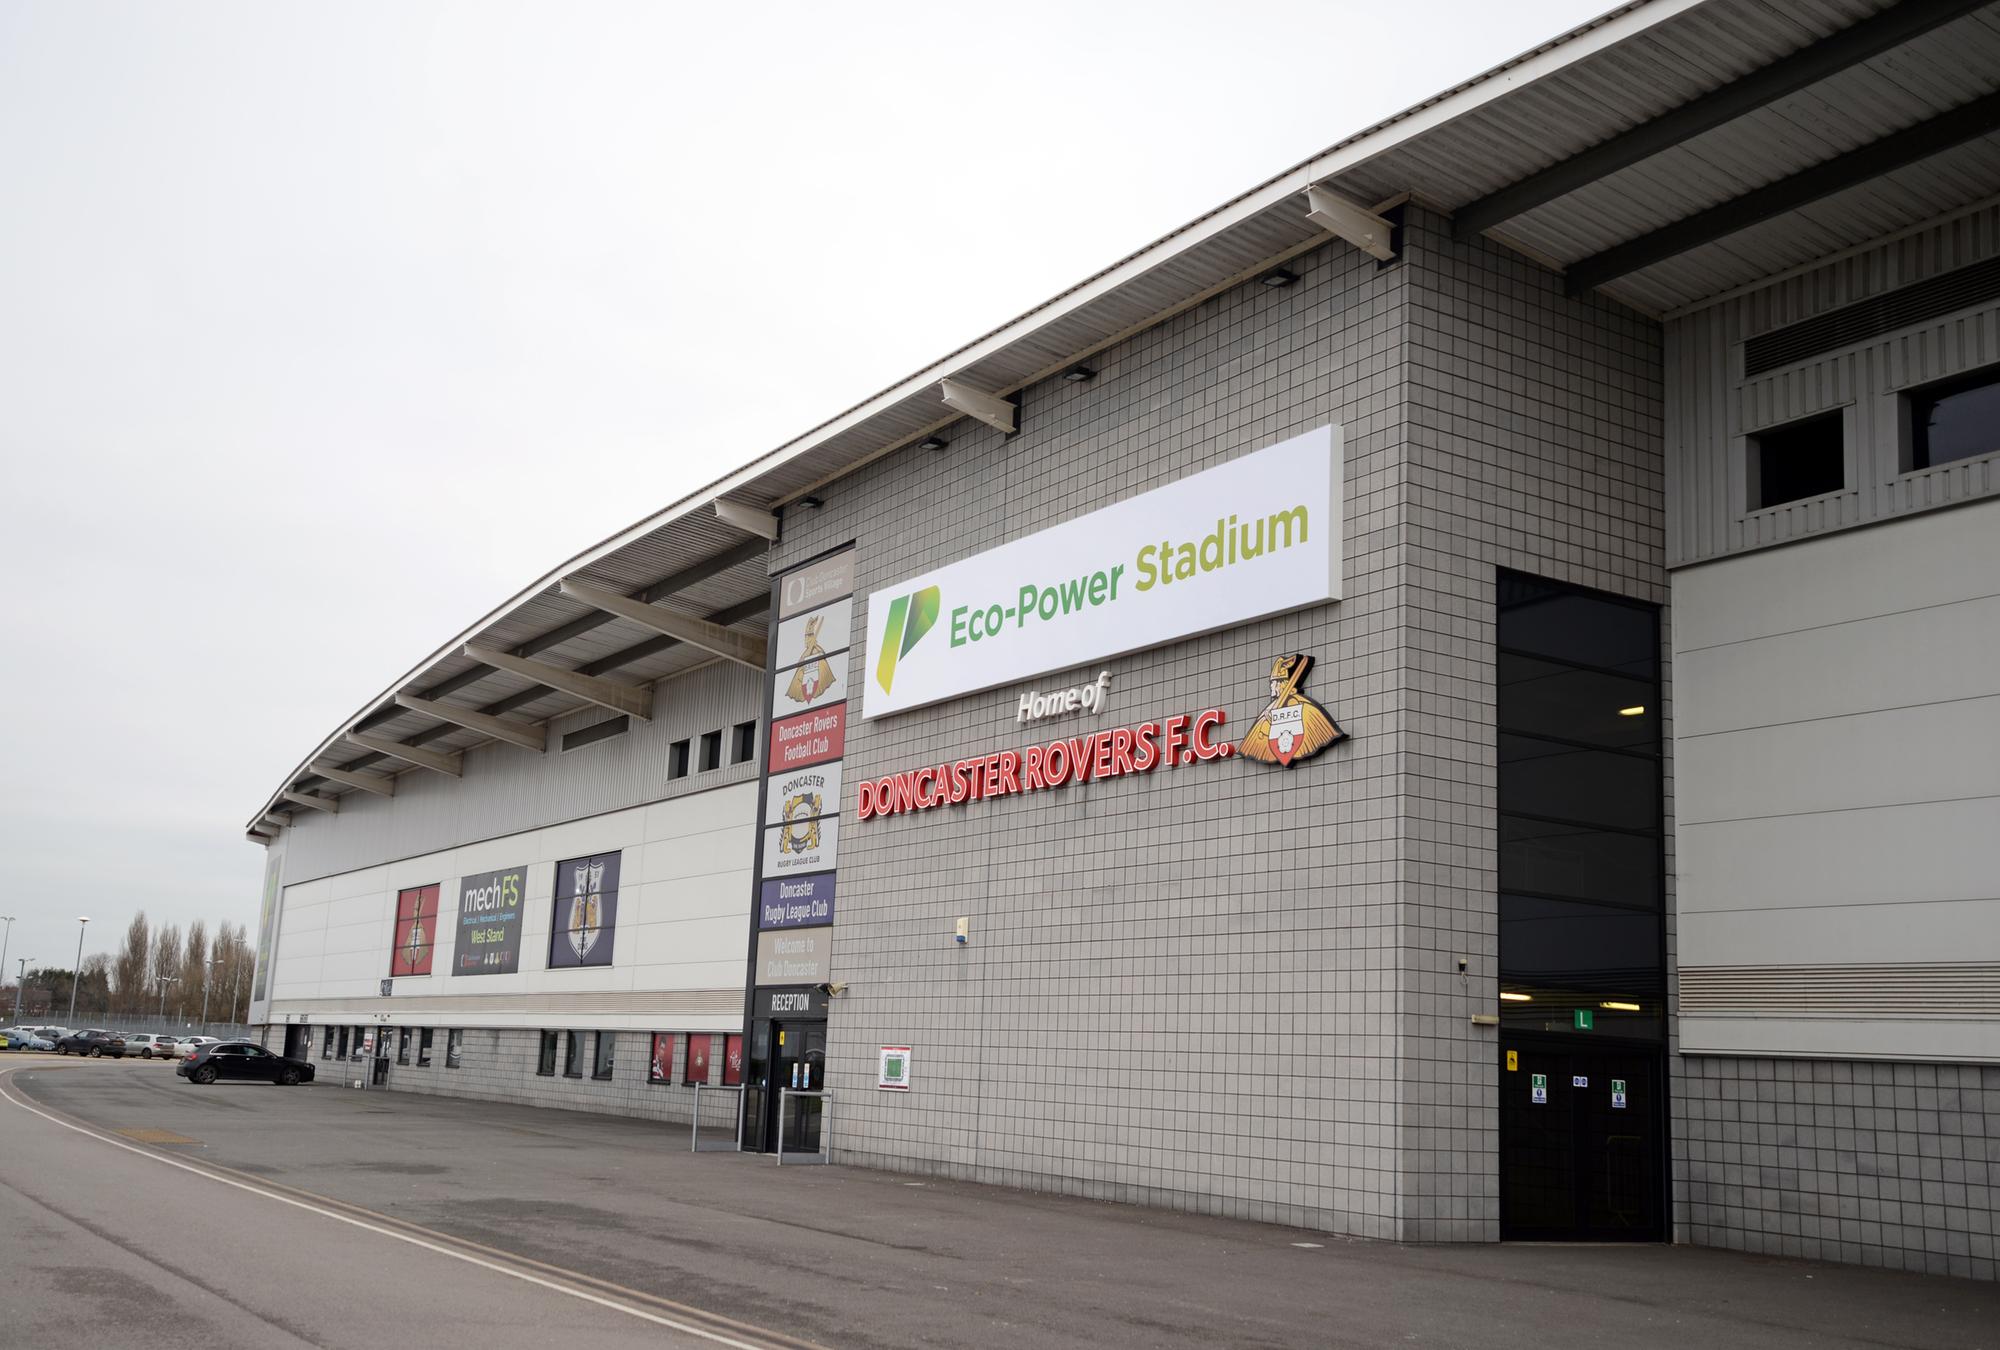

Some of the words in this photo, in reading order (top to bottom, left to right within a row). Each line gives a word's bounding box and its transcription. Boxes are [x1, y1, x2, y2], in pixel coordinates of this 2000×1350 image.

[950, 563, 1124, 648] Eco-Power
[1135, 504, 1308, 592] Stadium
[1017, 687, 1080, 724] Home
[1080, 671, 1113, 716] of
[1272, 709, 1300, 723] D.R.F.C.
[778, 719, 813, 742] Doncaster
[813, 712, 838, 733] Rovers
[784, 743, 812, 762] Football
[812, 738, 829, 756] Club
[858, 750, 1023, 821] DONCASTER
[1024, 721, 1160, 790] ROVERS
[1164, 709, 1234, 767] F.C.
[782, 774, 825, 796] DONCASTER
[777, 859, 792, 869] RUGBY
[792, 856, 808, 867] LEAGUE
[808, 854, 820, 865] CLUB
[464, 874, 519, 912] mechFS
[780, 882, 814, 900] Doncaster
[765, 904, 786, 925] Rugby
[786, 901, 812, 922] League
[811, 898, 828, 917] Club
[471, 928, 486, 944] West
[486, 926, 504, 943] Stand
[774, 937, 806, 957] Welcome
[807, 936, 815, 953] to
[784, 958, 819, 977] Doncaster
[772, 993, 810, 1012] RECEPTION
[1579, 1011, 1588, 1028] L
